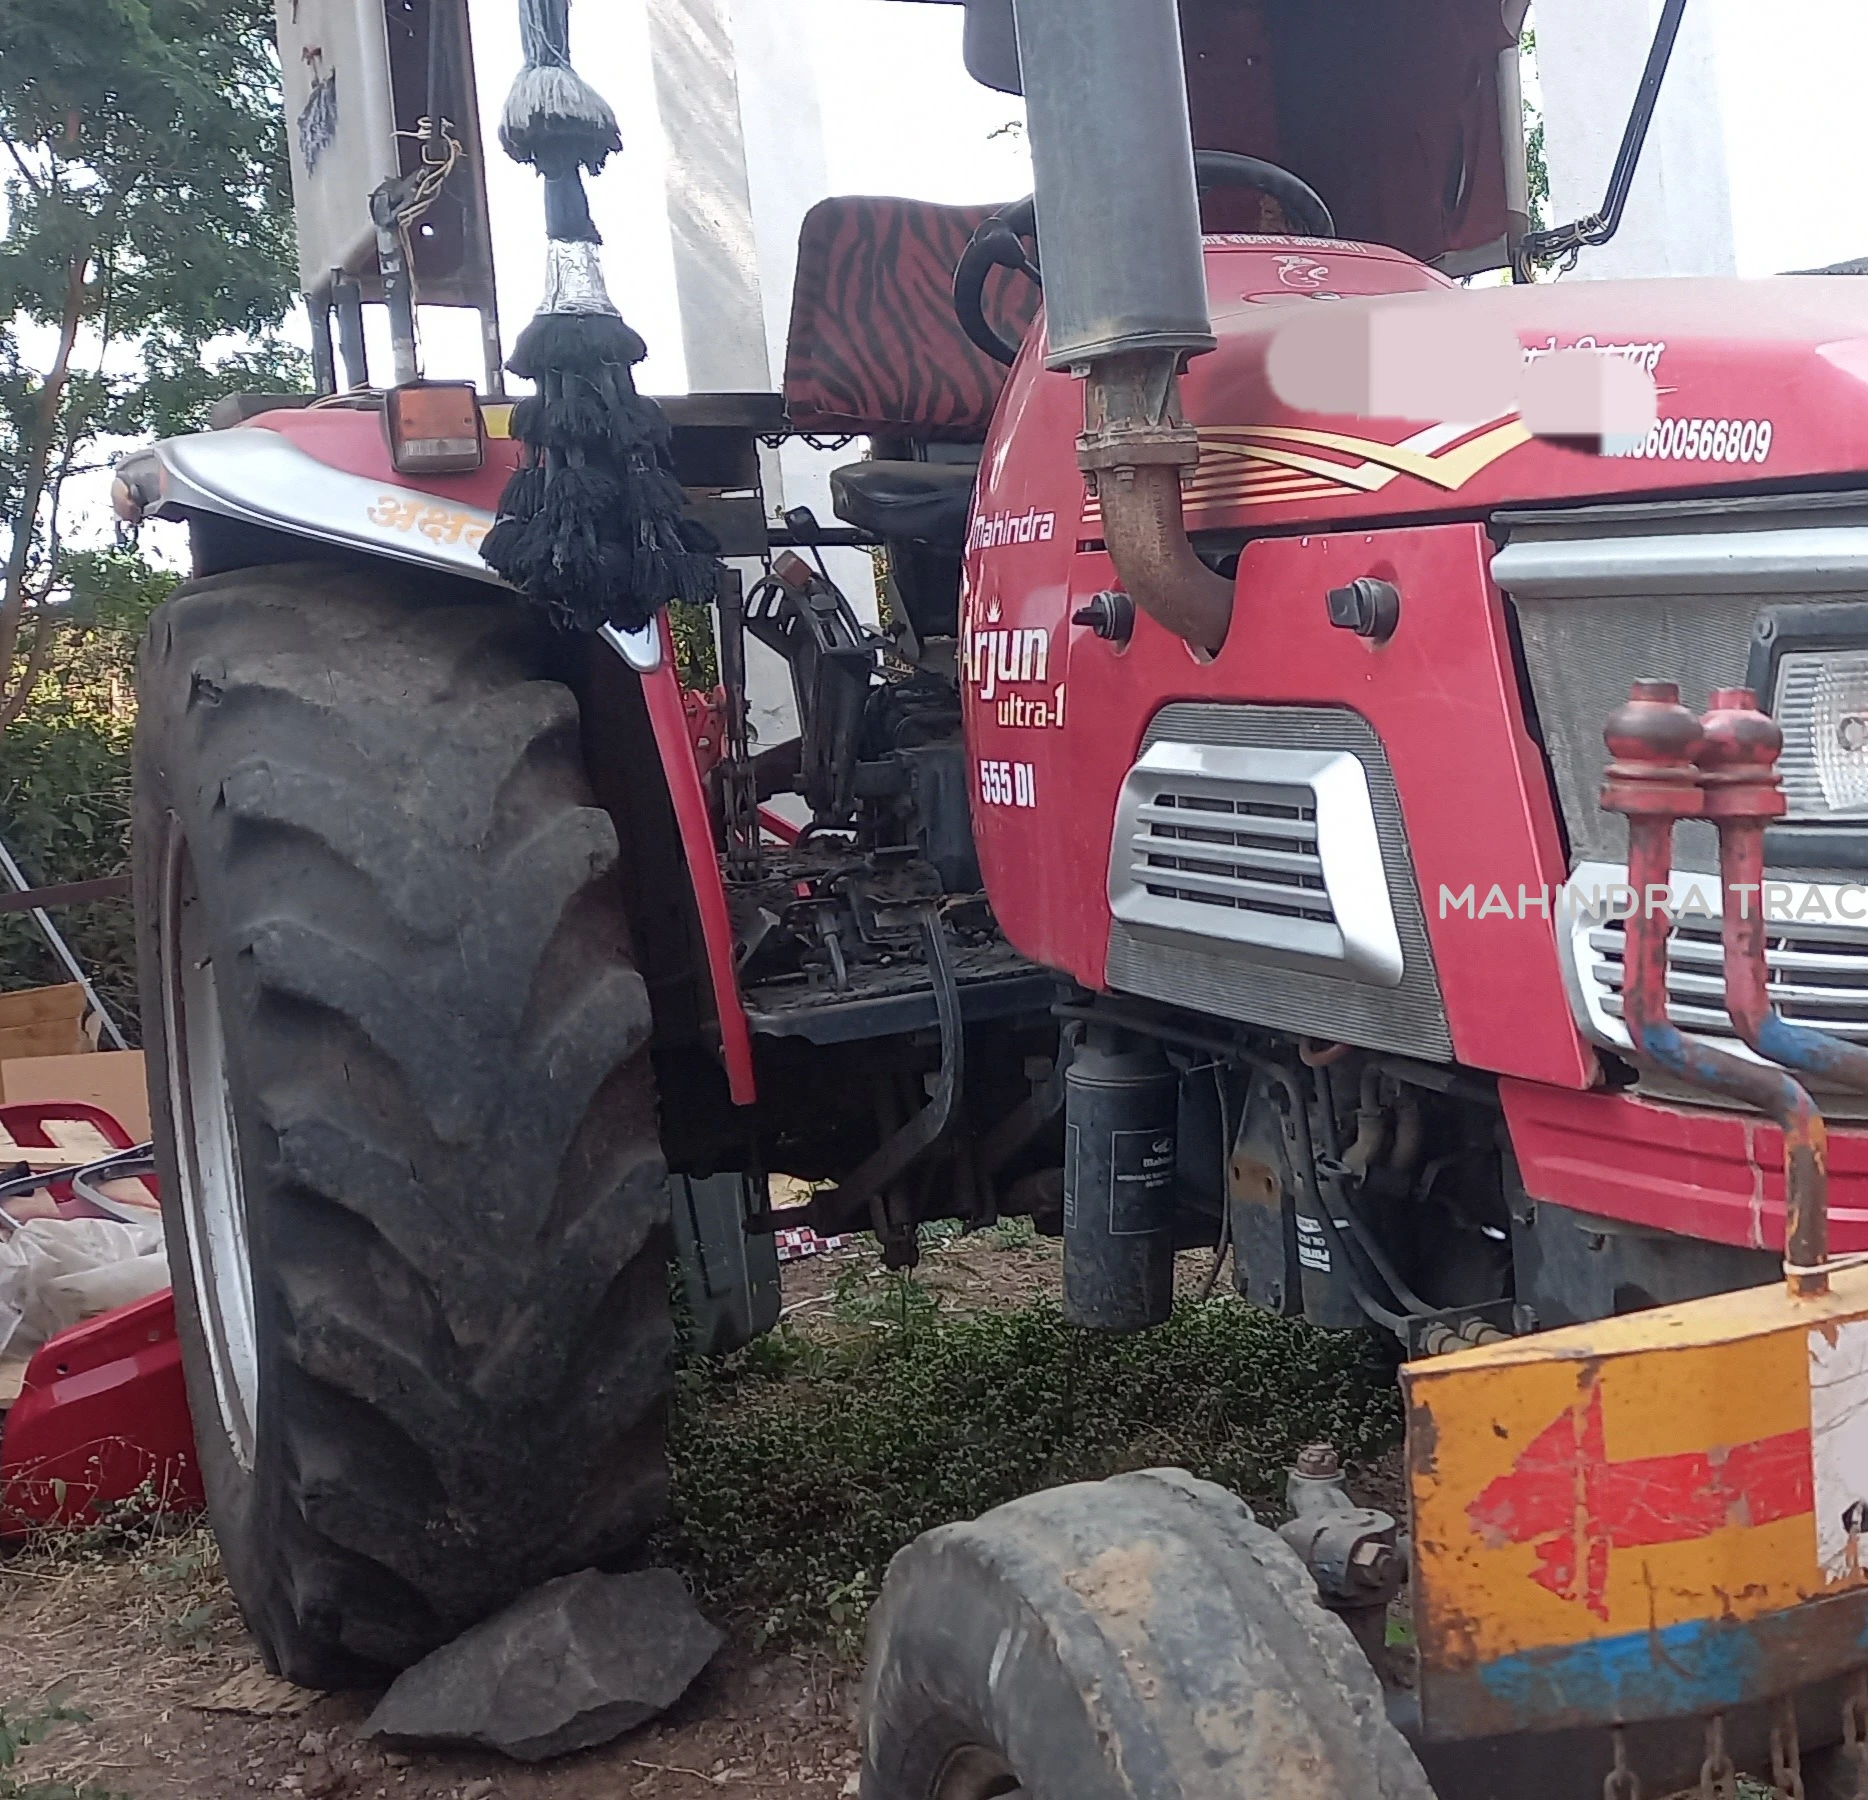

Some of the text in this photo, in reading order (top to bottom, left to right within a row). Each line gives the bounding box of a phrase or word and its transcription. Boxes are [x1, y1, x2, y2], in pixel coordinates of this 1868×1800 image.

[960, 614, 1049, 700] Arjun
[996, 682, 1067, 728] ultra-1
[979, 760, 1036, 808] 555 DI
